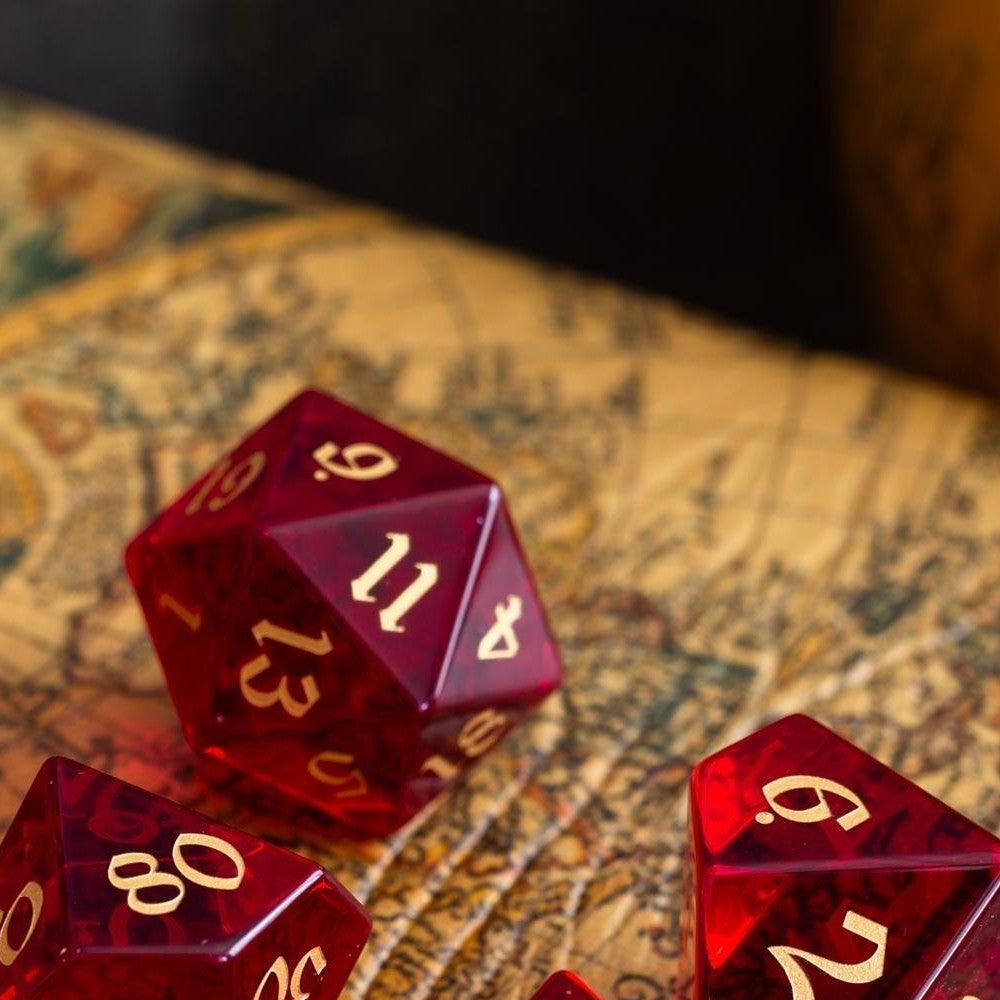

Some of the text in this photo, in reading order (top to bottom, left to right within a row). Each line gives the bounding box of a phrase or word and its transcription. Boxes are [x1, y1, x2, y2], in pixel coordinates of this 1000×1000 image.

[351, 532, 438, 633] 11
[477, 594, 523, 660] 4
[240, 619, 334, 718] 13
[107, 833, 245, 915] 80
